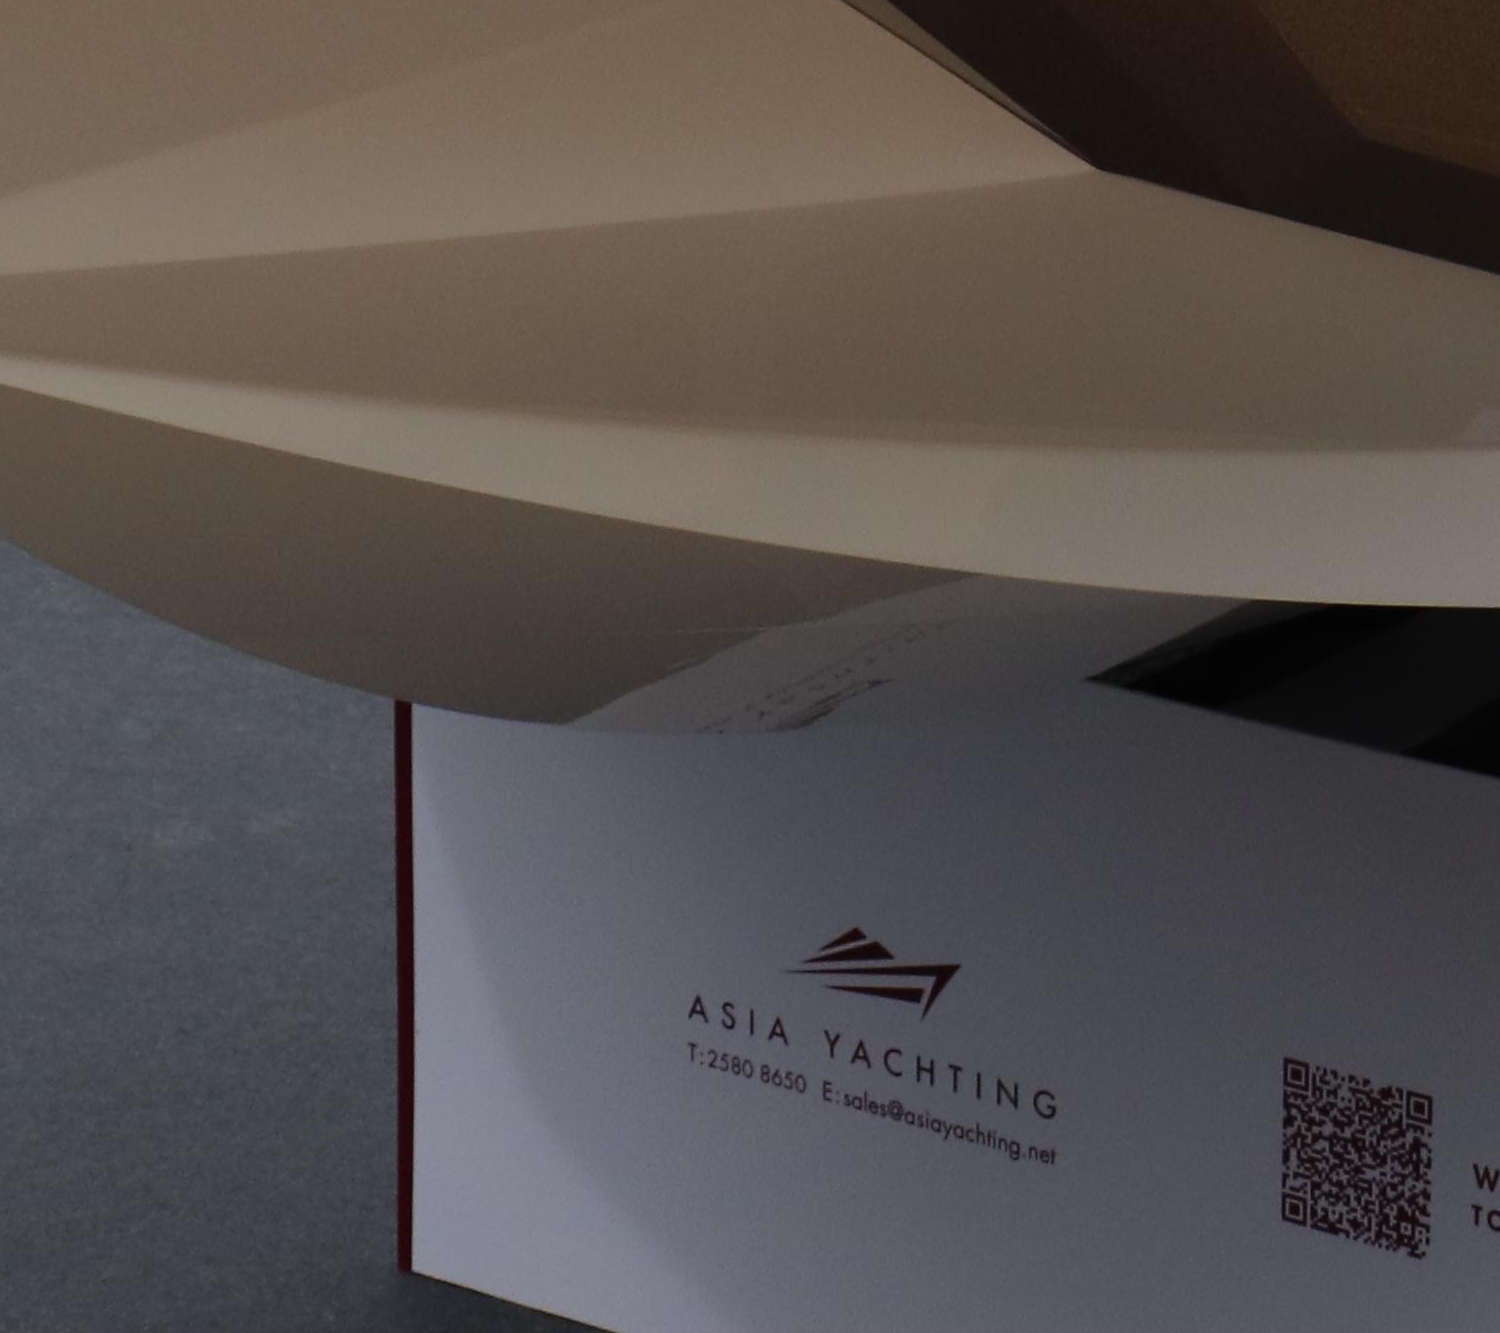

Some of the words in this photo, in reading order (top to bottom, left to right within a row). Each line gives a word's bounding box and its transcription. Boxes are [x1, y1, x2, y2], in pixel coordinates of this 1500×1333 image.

[687, 994, 790, 1046] ASIA
[823, 1029, 1058, 1121] YACHTING
[759, 1063, 808, 1095] 8650
